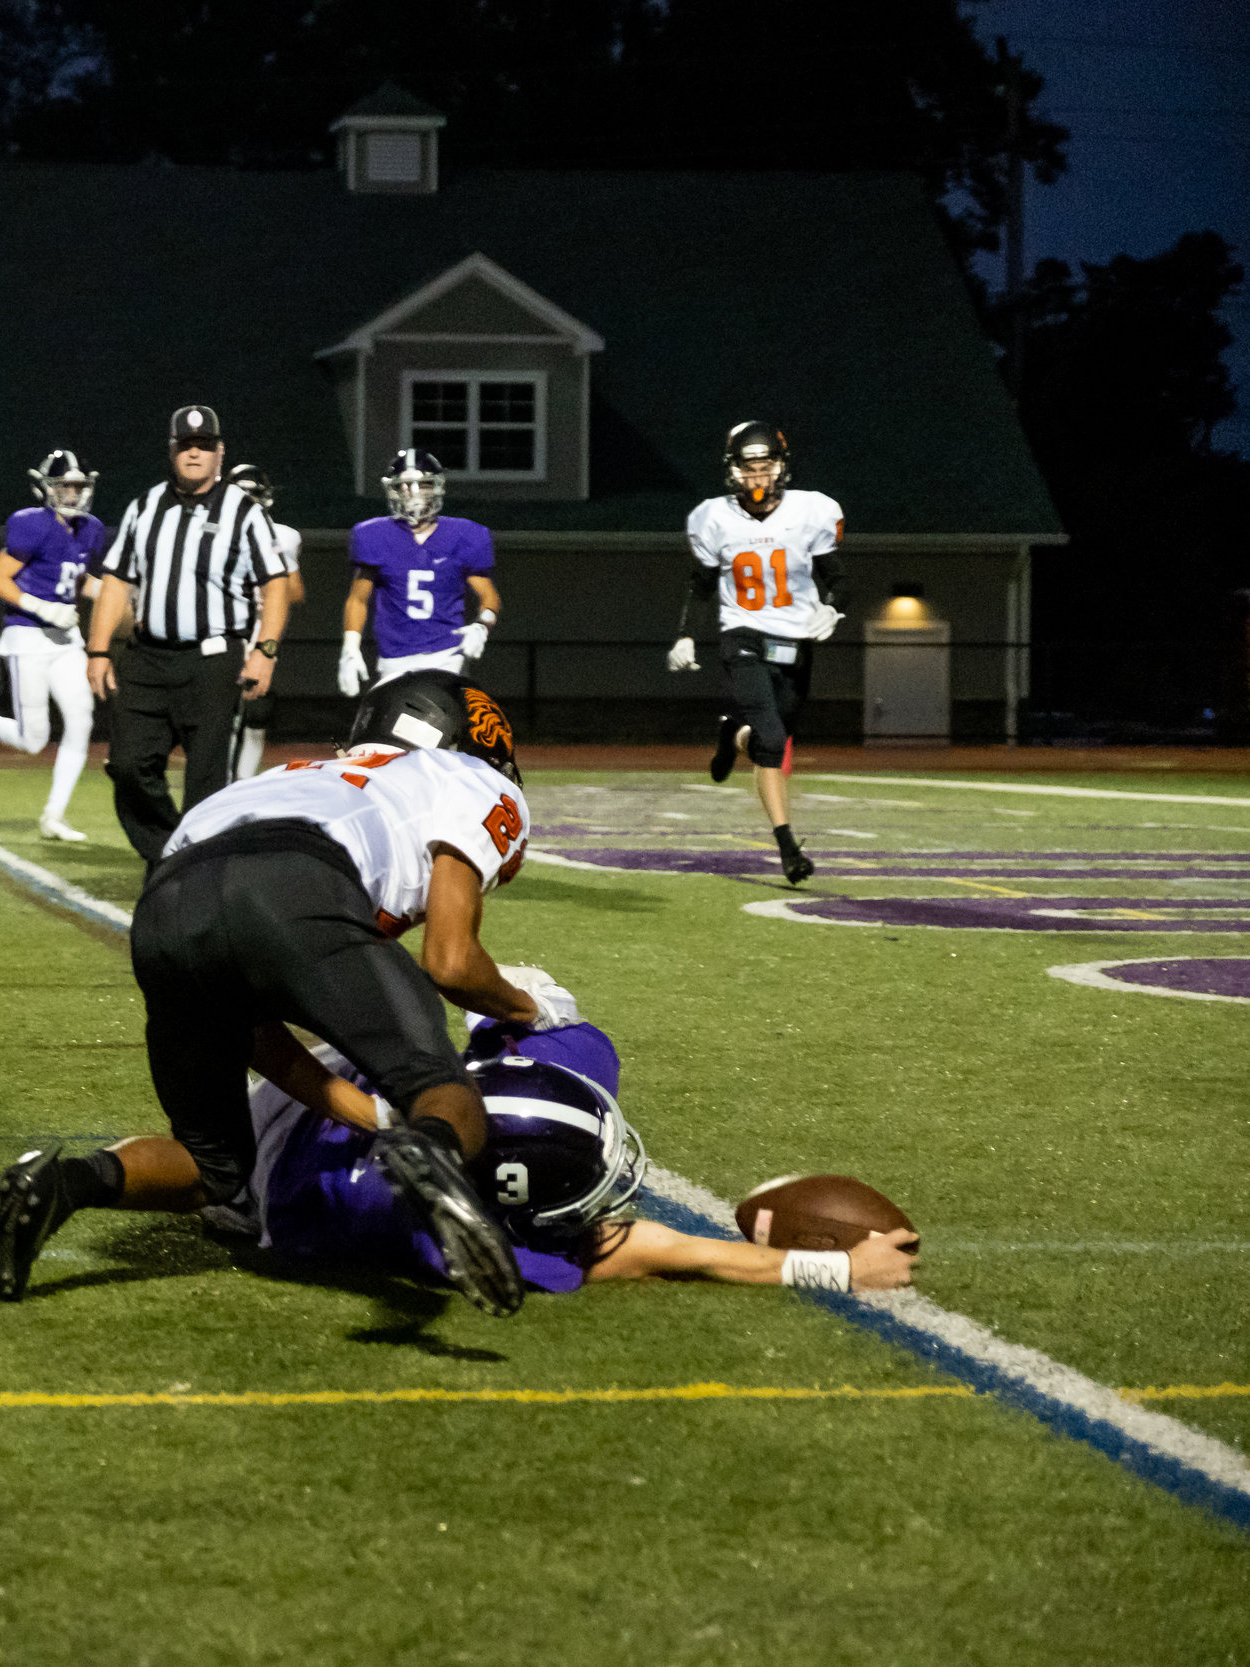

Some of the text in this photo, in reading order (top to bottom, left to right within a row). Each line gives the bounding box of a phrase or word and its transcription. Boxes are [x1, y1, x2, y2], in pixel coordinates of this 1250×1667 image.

[406, 569, 435, 620] 5
[733, 548, 794, 611] 81
[496, 1162, 529, 1206] 3
